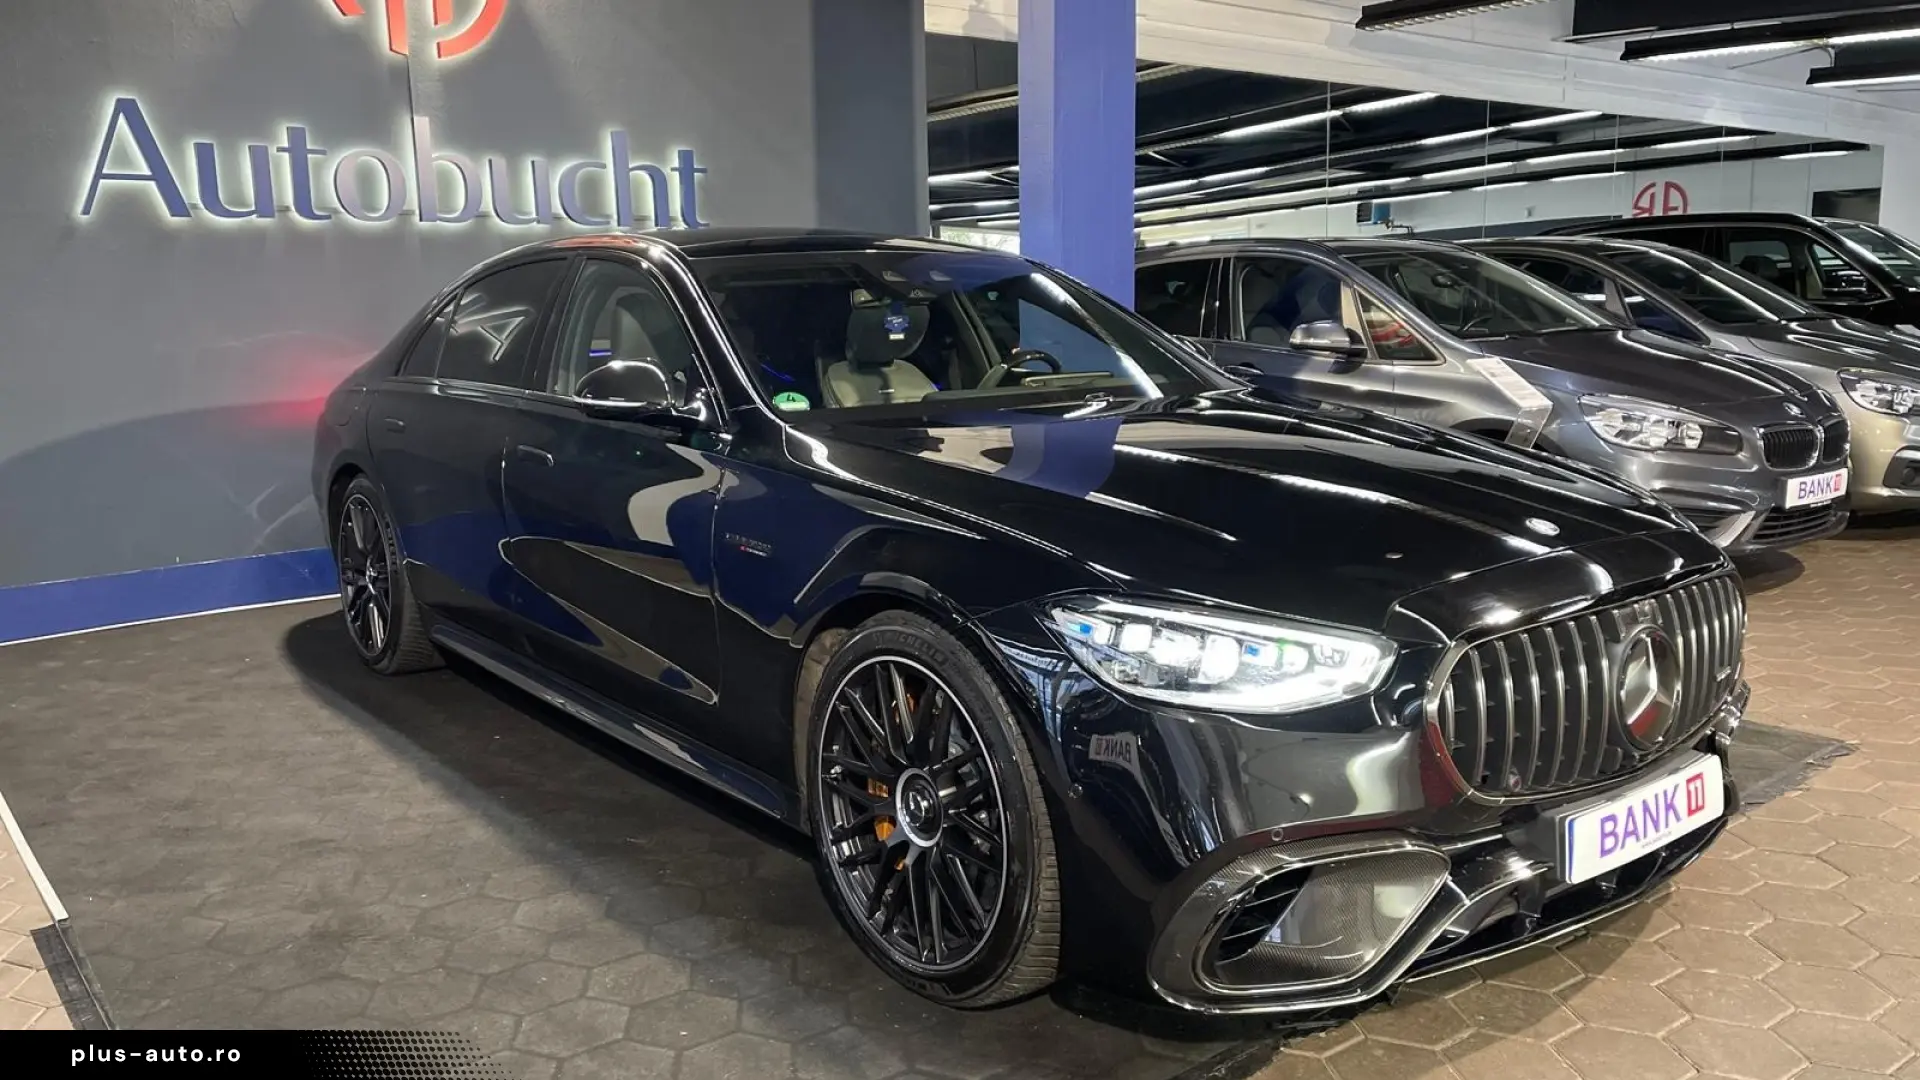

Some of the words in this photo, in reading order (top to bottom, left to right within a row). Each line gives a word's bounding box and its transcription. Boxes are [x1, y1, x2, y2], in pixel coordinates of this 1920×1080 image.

[80, 97, 710, 229] Autobucht
[1797, 475, 1833, 499] BANK
[1599, 783, 1682, 859] BANK
